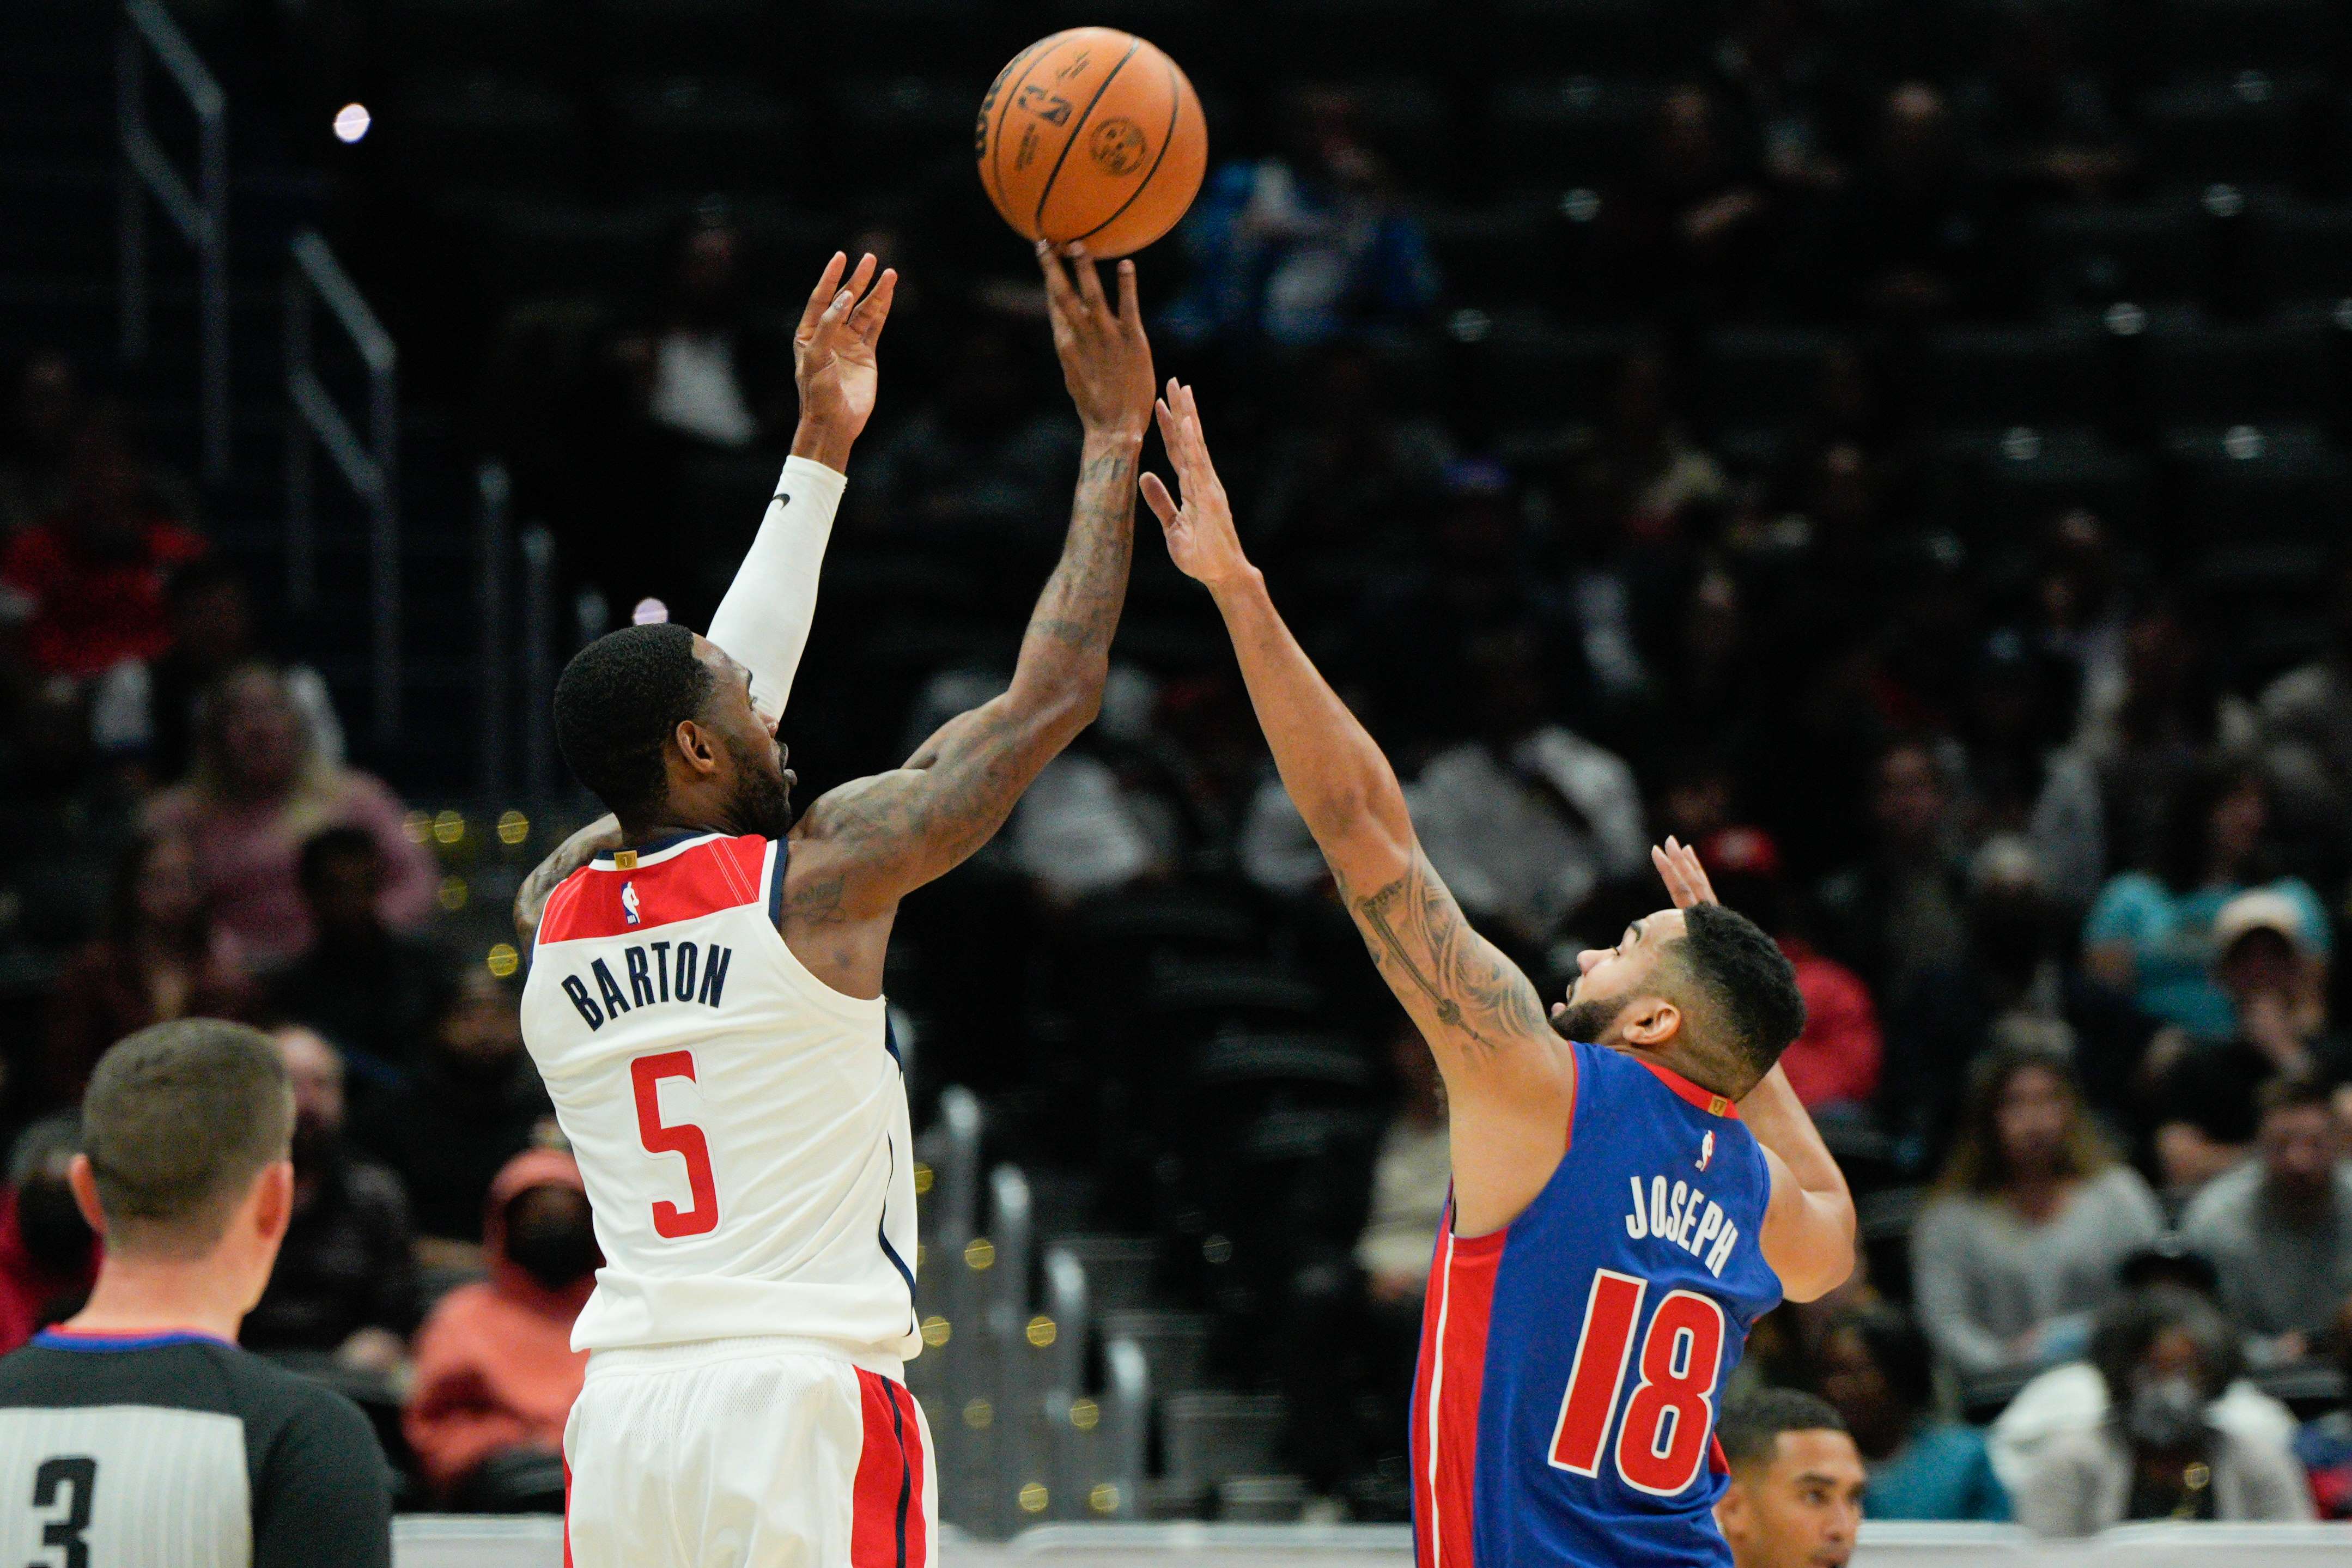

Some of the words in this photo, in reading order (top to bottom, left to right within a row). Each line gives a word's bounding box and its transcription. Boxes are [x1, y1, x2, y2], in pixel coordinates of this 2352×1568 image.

[561, 941, 732, 1032] BARTON
[630, 1049, 719, 1239] 5
[1626, 1175, 1739, 1279] JOSEPH
[1547, 1268, 1725, 1497] 18
[26, 1456, 97, 1568] 3
